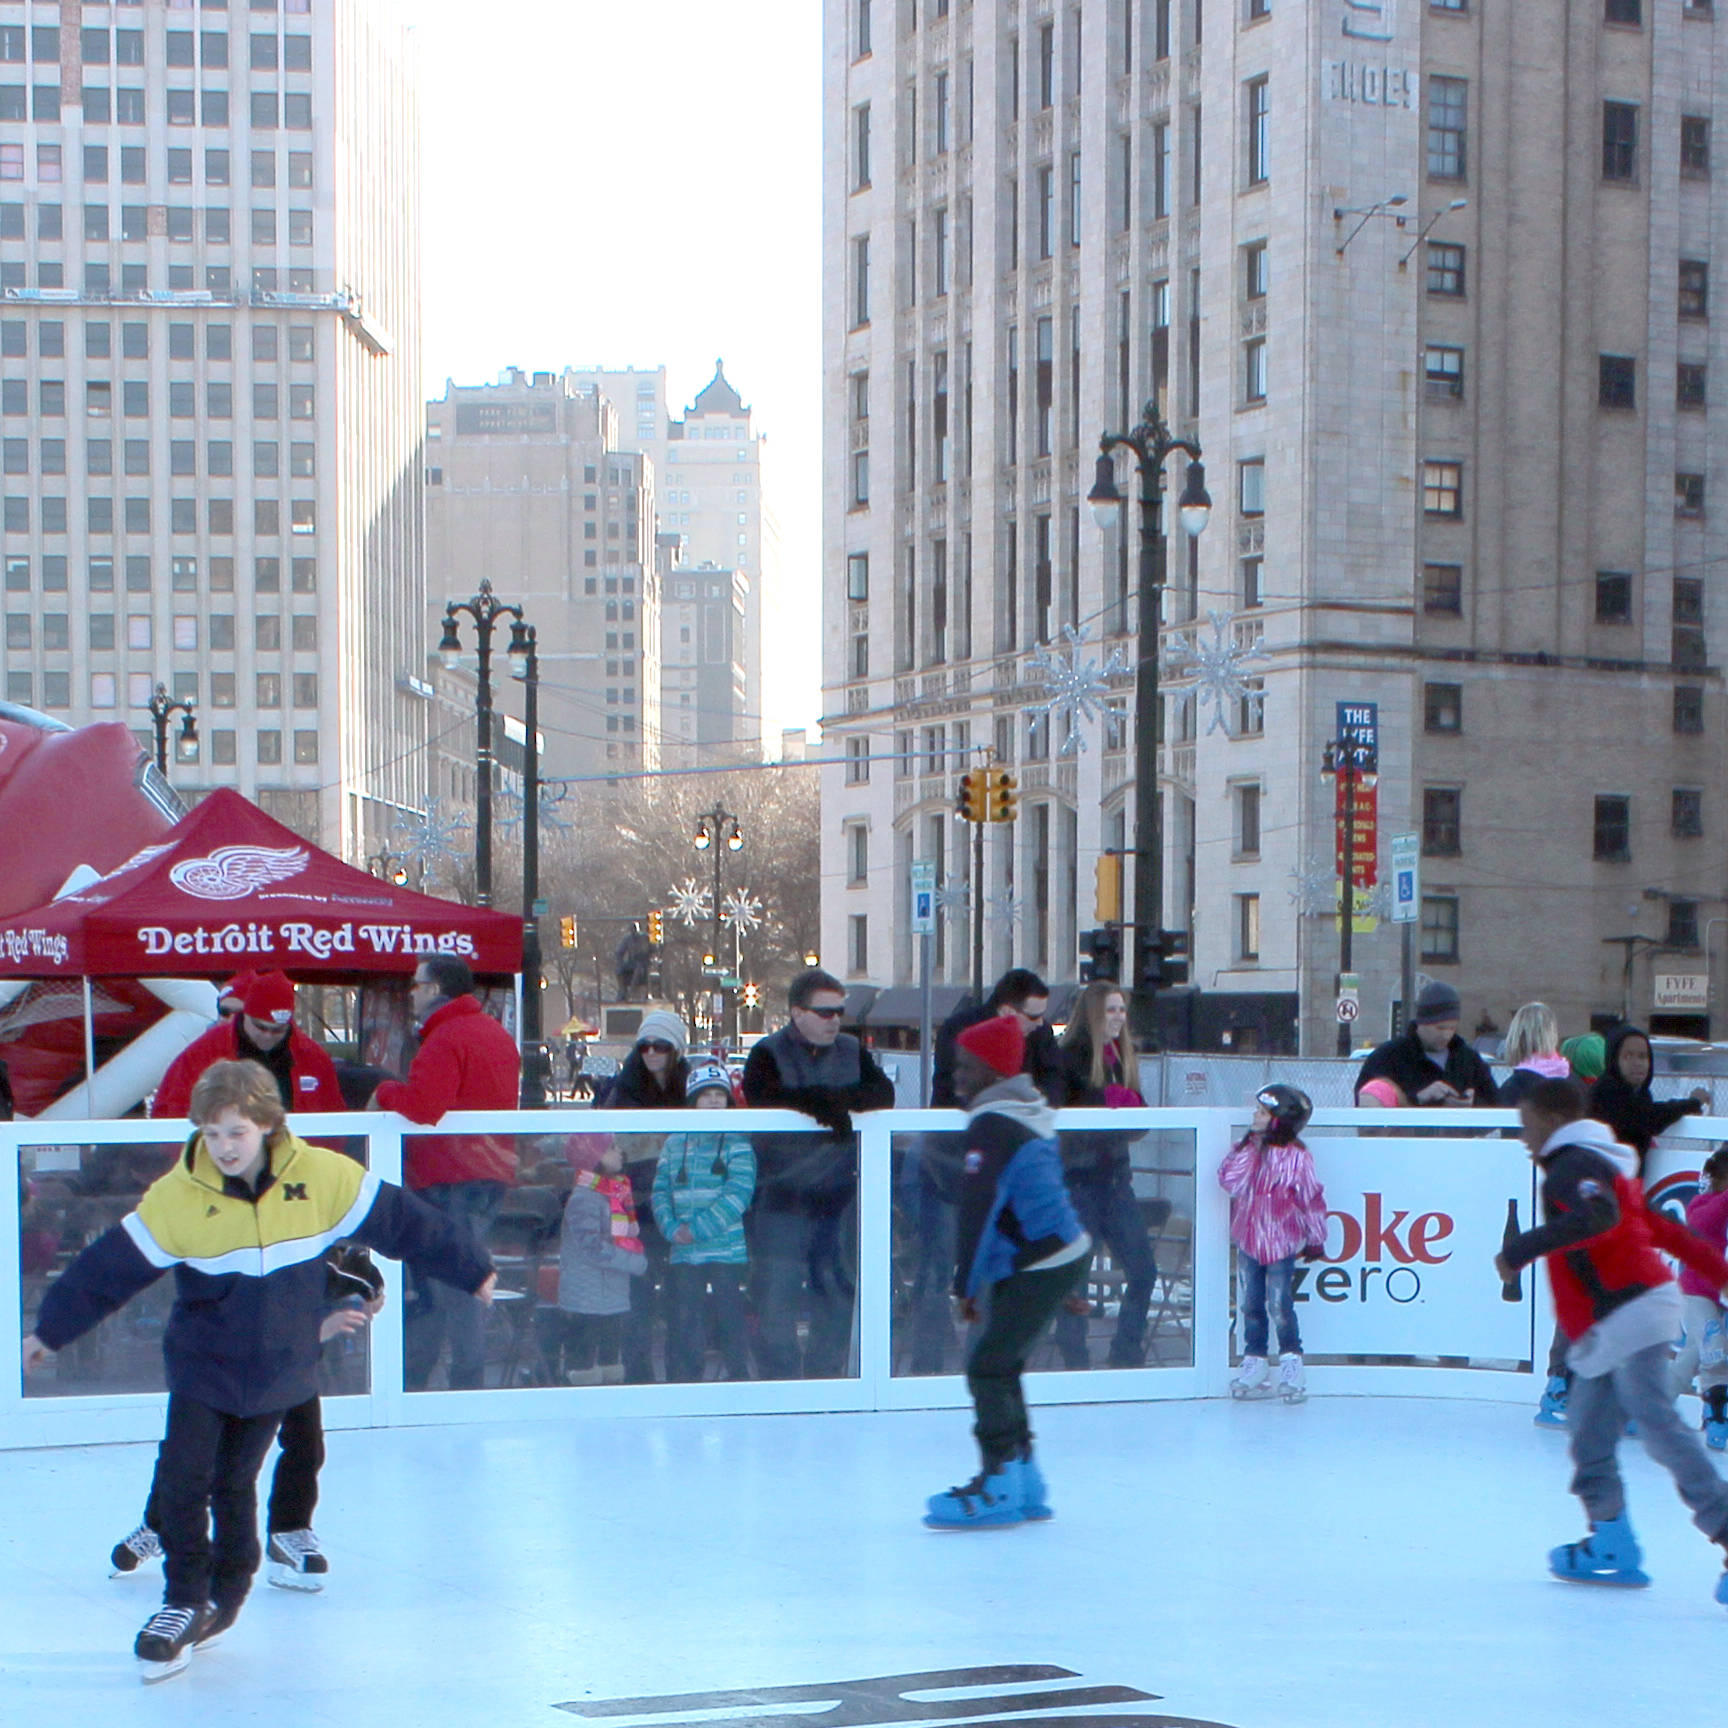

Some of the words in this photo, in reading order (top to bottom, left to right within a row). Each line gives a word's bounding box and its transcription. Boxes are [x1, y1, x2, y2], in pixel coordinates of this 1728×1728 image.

[1344, 709, 1371, 724] THE
[5, 928, 29, 963] Red
[137, 923, 275, 955] Detroit
[280, 923, 355, 959] Red
[1666, 977, 1697, 990] FYFE
[283, 1182, 310, 1201] M
[1317, 1192, 1454, 1264] oke
